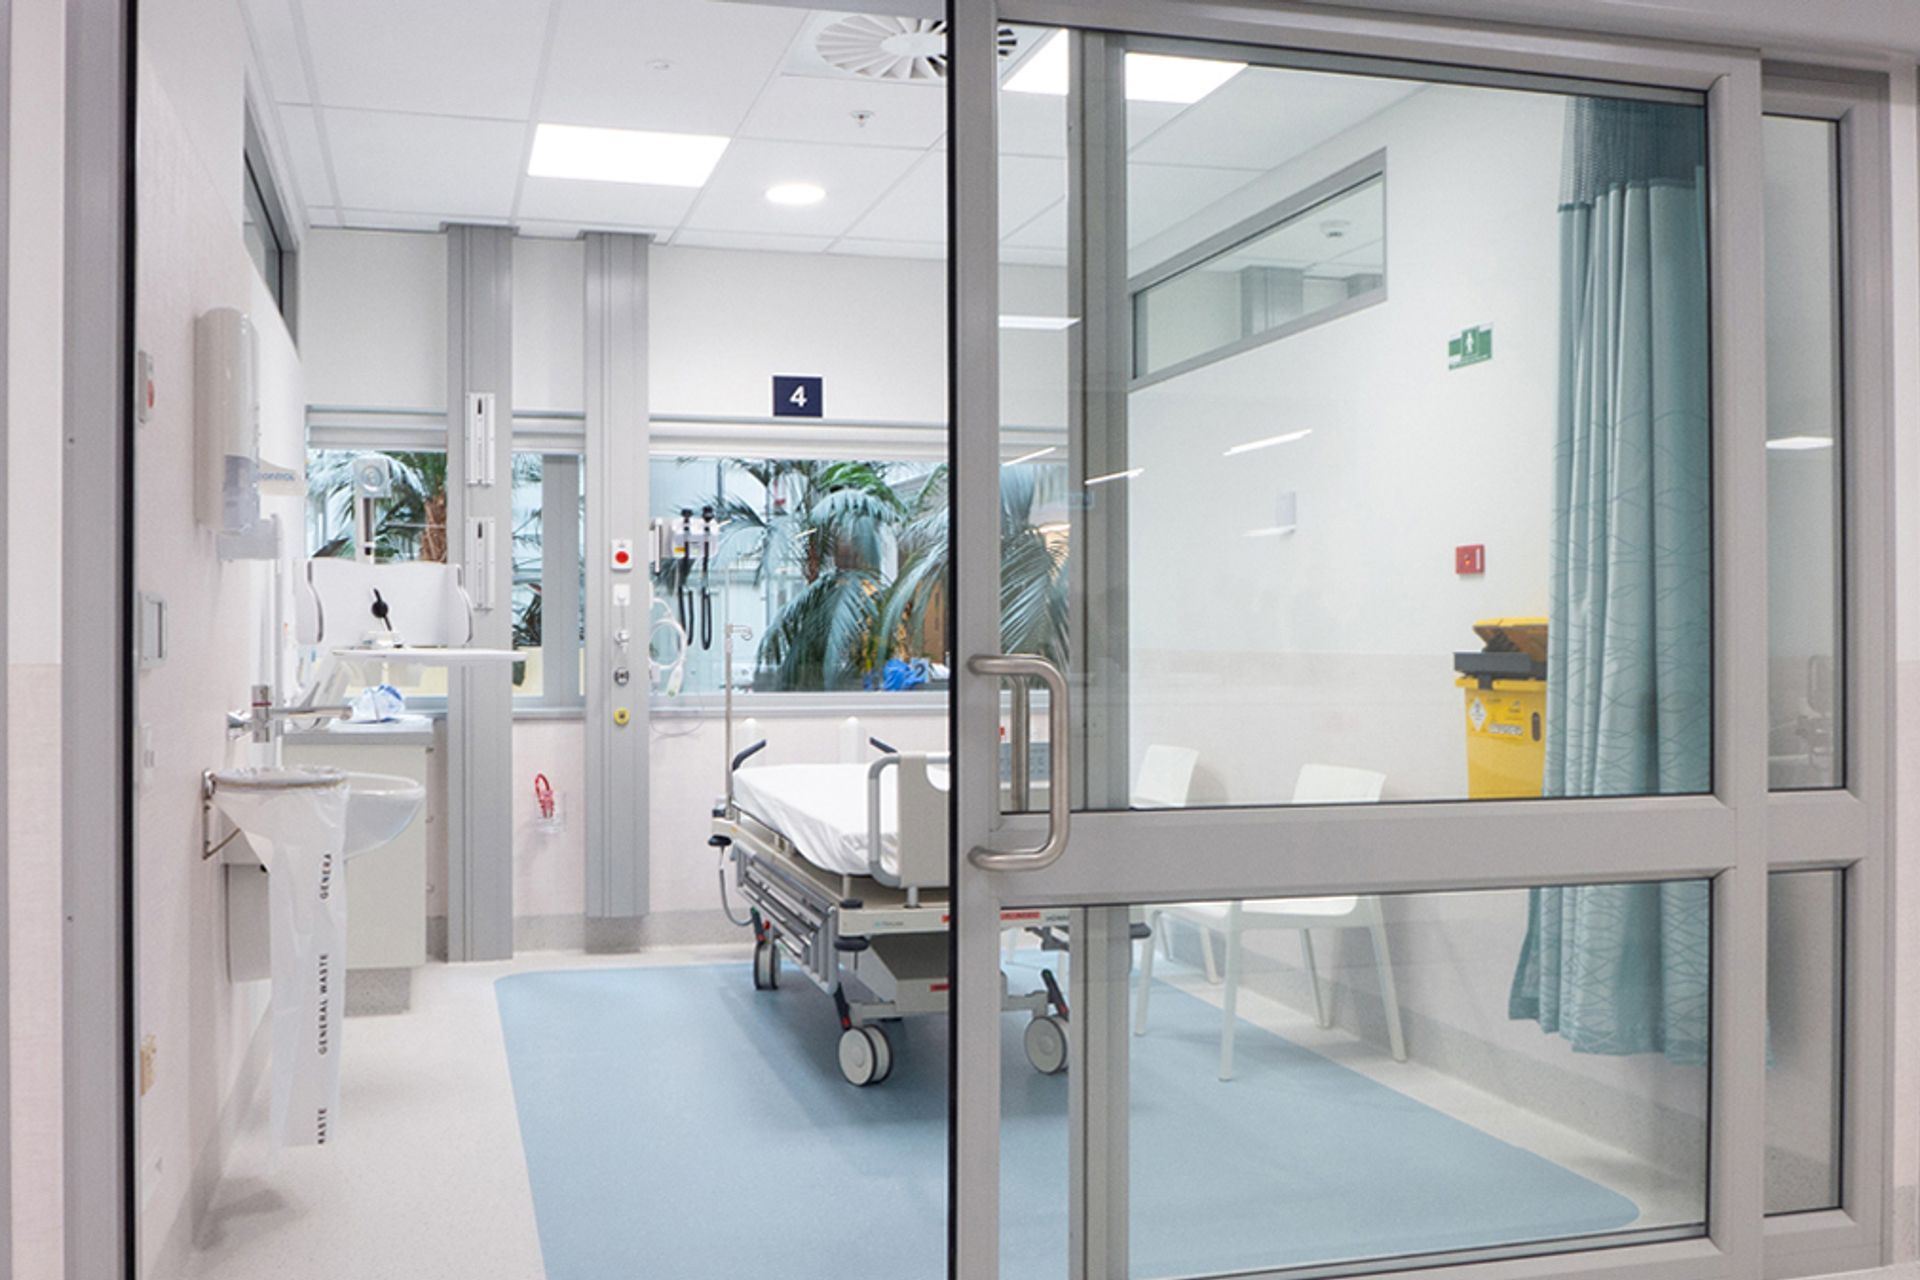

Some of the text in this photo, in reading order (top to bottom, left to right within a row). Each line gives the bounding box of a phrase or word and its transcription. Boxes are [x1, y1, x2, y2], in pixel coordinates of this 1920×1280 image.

[789, 385, 808, 408] 4
[318, 954, 328, 1055] GENERAL WASTE
